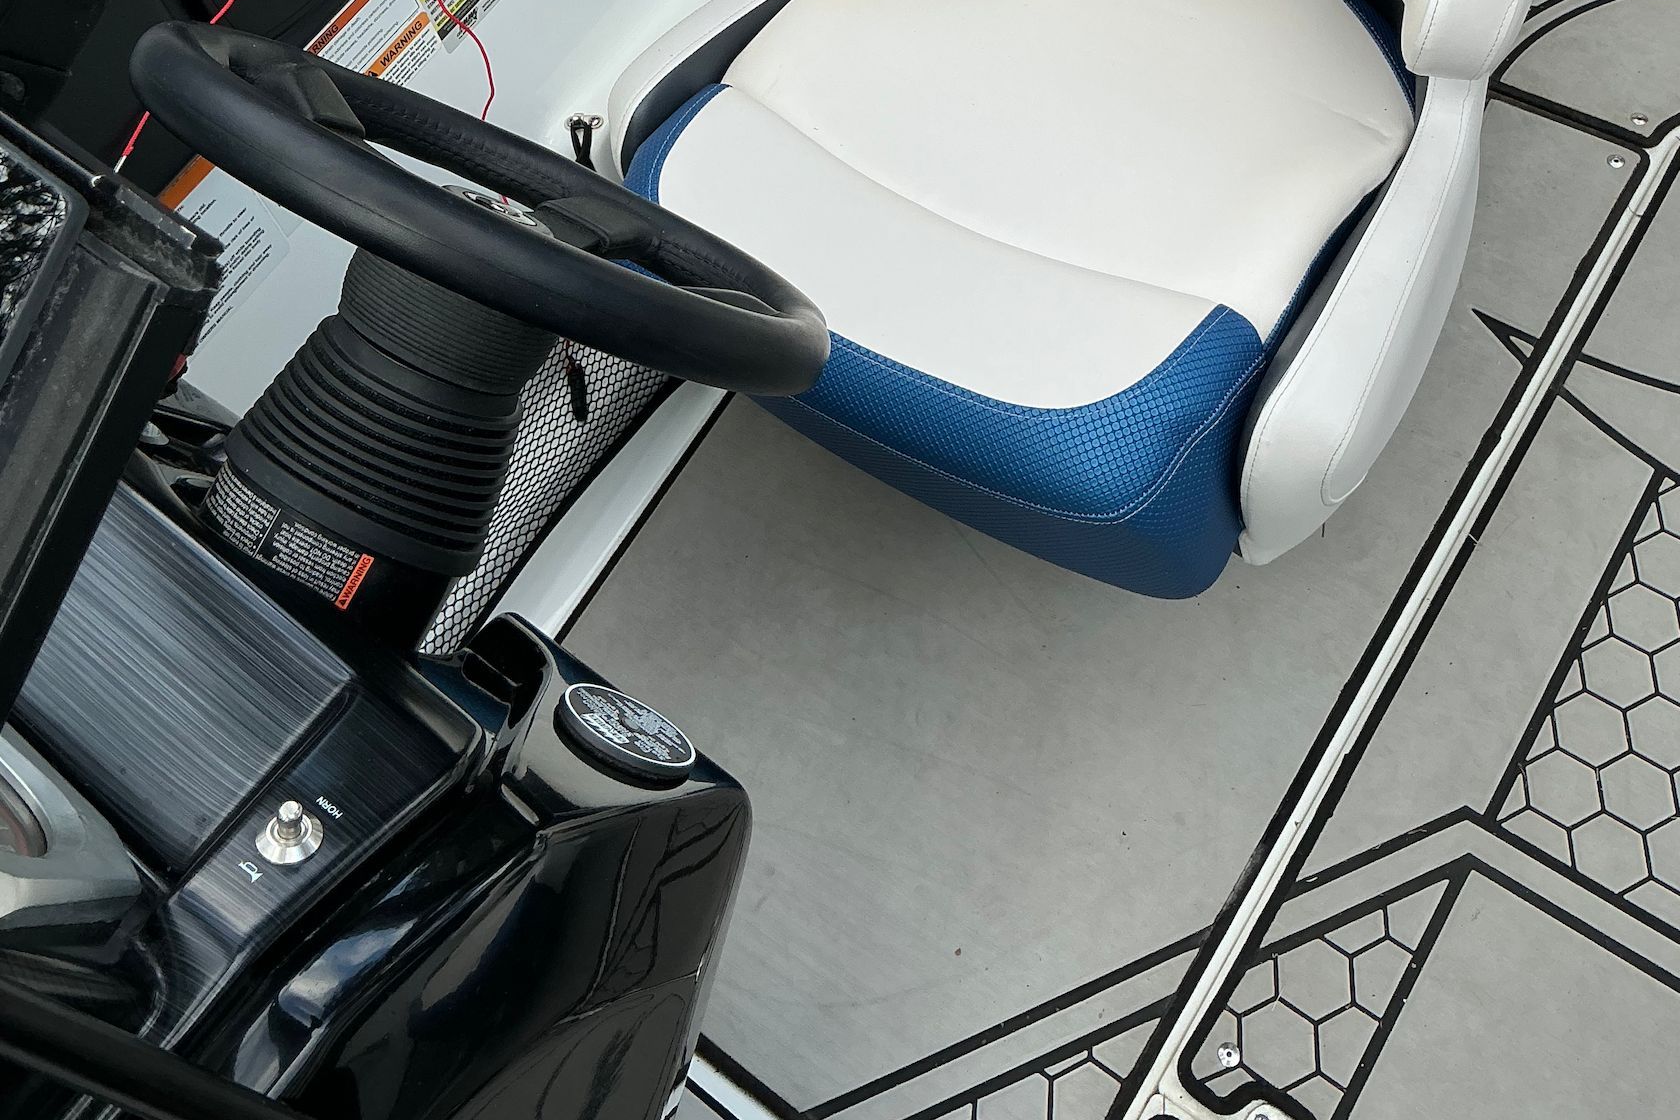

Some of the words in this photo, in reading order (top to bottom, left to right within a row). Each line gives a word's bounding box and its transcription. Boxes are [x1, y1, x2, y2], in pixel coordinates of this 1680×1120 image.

[311, 24, 339, 53] RNING
[380, 20, 423, 67] WARNING
[341, 557, 372, 600] WARNING
[316, 796, 343, 819] HORN
